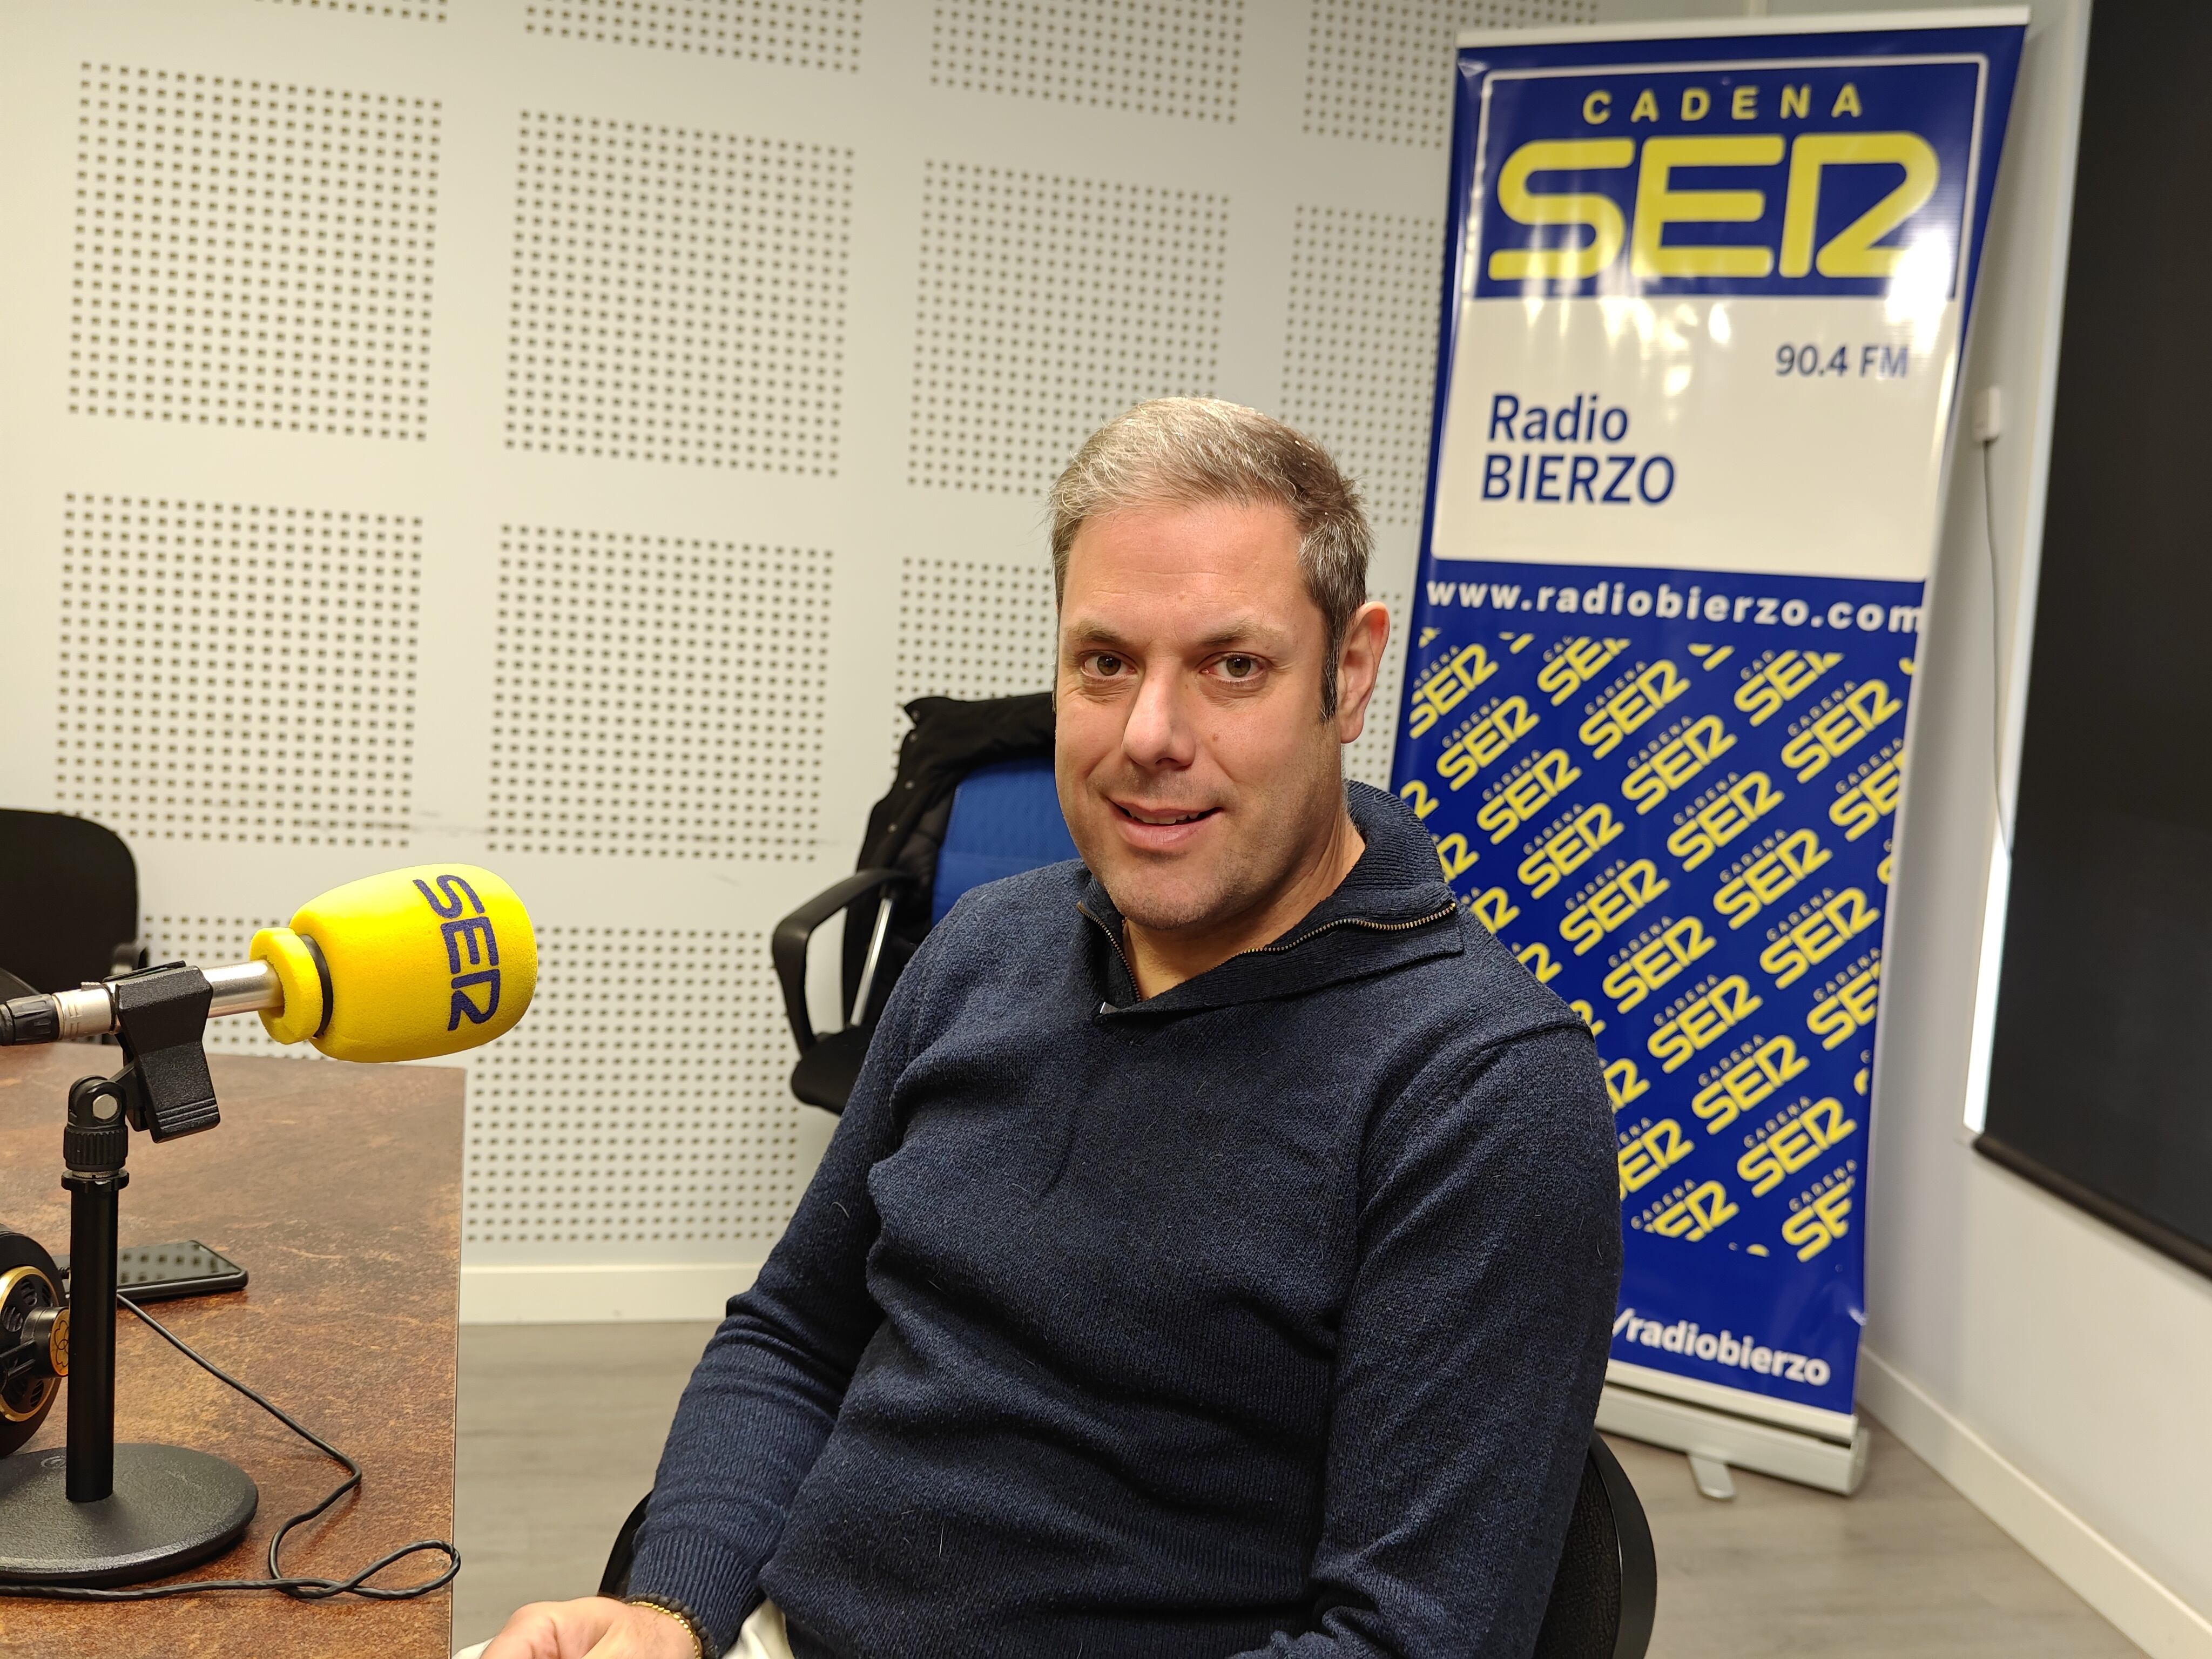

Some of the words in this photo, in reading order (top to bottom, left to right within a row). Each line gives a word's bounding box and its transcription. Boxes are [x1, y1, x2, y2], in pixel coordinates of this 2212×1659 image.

[1583, 84, 1862, 124] CADENA
[1488, 132, 1940, 281] SER
[1775, 345, 1848, 378] 90.4
[1859, 346, 1909, 377] FM
[1488, 394, 1629, 443] Radio
[1481, 454, 1675, 505] BIERZO
[1426, 579, 1924, 635] www.radiobierzo.com
[1537, 638, 1628, 705] SE
[1579, 660, 1689, 759] SER
[1437, 696, 1539, 790] SER
[1622, 716, 1735, 814] SER
[1782, 680, 1900, 783] SER
[1477, 750, 1580, 844] SER
[1667, 772, 1783, 871] SER
[1829, 751, 1904, 840] SE
[1518, 804, 1623, 899] SER
[1714, 830, 1830, 928] SER
[413, 875, 501, 1031] SER
[1560, 860, 1669, 955] SER
[1760, 888, 1878, 988] SER
[1603, 917, 1715, 1013] SER
[1807, 962, 1880, 1049] SE
[1648, 976, 1761, 1073] SER
[1692, 1036, 1808, 1134] SER
[1617, 1120, 1692, 1199] ER
[1737, 1098, 1855, 1196] SER
[1645, 1181, 1737, 1242] ER
[1782, 1178, 1852, 1260] SE
